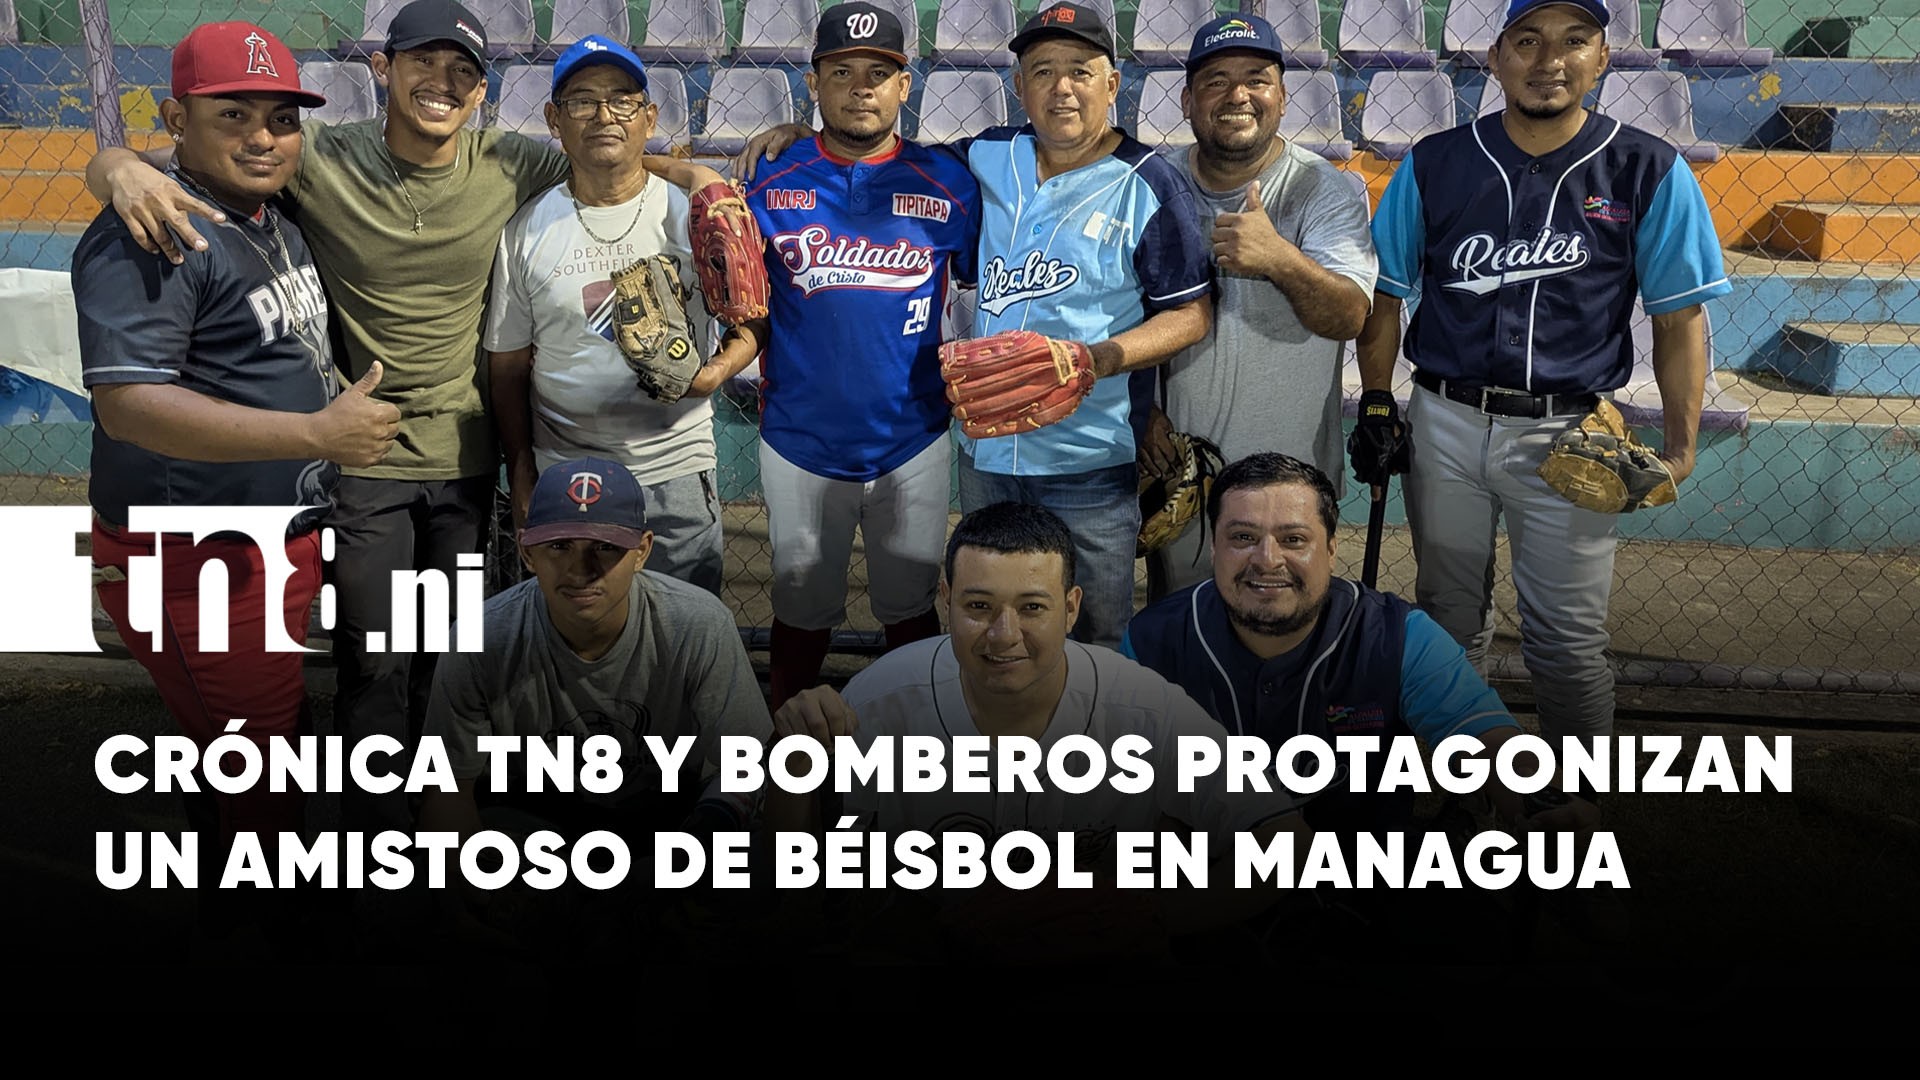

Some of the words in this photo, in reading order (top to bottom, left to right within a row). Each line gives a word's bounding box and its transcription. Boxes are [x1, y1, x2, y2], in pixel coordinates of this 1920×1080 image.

[1204, 27, 1257, 47] Electrolit
[245, 32, 279, 78] A
[766, 189, 817, 211] IMRJ
[894, 194, 948, 221] TIPITAPA
[573, 243, 635, 260] DEXTER
[774, 226, 933, 275] Soldados
[1450, 229, 1585, 282] Reales
[553, 258, 635, 278] SOUTHFIE
[808, 275, 824, 289] de
[827, 271, 866, 285] Cristo
[982, 250, 1068, 303] Reales
[902, 297, 932, 335] 29
